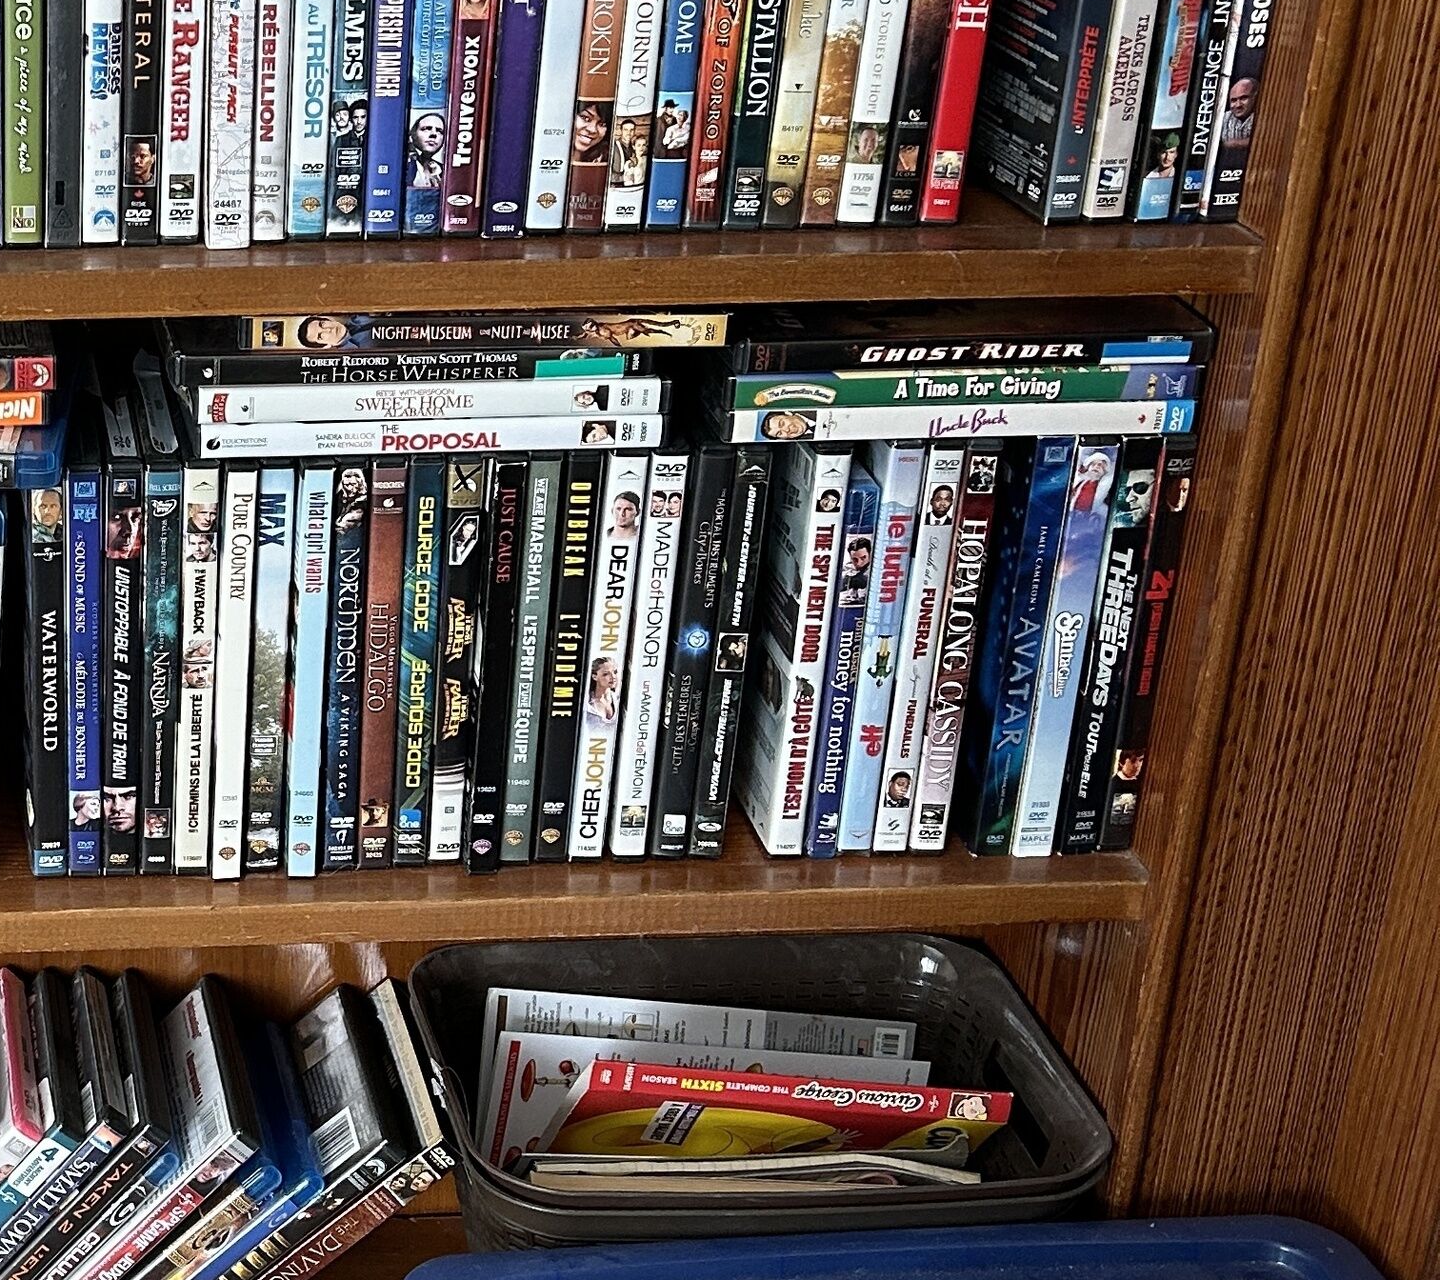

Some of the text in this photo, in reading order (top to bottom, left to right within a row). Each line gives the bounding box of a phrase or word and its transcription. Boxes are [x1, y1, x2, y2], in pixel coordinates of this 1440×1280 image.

[170, 19, 200, 143] RANGER
[259, 4, 281, 143] RÉBELLION
[301, 365, 519, 383] THE HORSE WHISPERER
[860, 342, 1085, 363] GHOST RIDER
[893, 376, 1061, 400] A Time For Giving
[355, 394, 474, 412] SWEET HOME
[381, 433, 502, 452] PROPOSAL
[258, 491, 288, 547] MAX
[412, 495, 435, 634] SOURCE CODE
[564, 482, 592, 577] OUTBREAK
[41, 610, 59, 753] WATERWORLD
[367, 602, 391, 714] HIDALGO
[922, 517, 989, 792] HOPALONG CASSIDY
[996, 616, 1040, 750] AVATAR
[791, 1081, 924, 1113] Curious George
